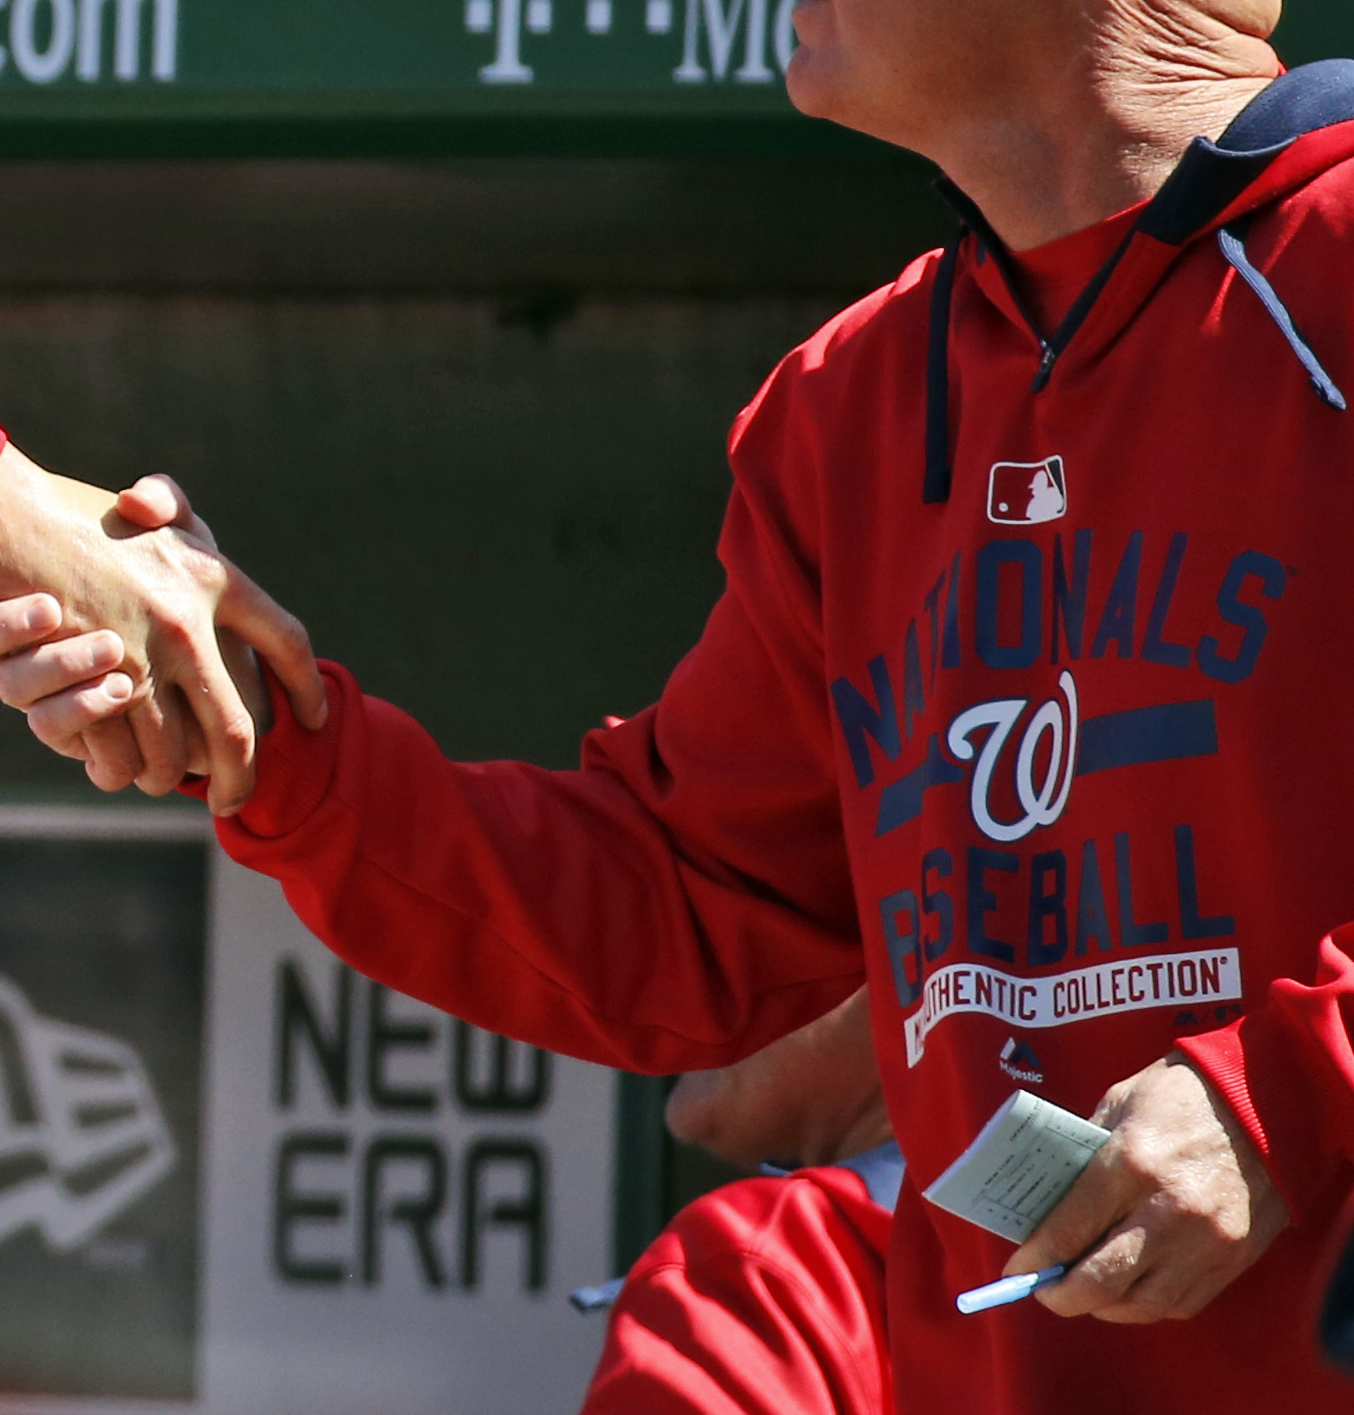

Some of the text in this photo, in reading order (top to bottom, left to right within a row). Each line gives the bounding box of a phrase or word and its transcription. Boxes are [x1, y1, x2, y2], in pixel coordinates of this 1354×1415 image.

[831, 528, 1286, 789] NATIONALS
[878, 824, 1236, 1008] BSEBALL
[1053, 957, 1221, 1019] COLLECTION
[273, 1133, 549, 1292] ERA
